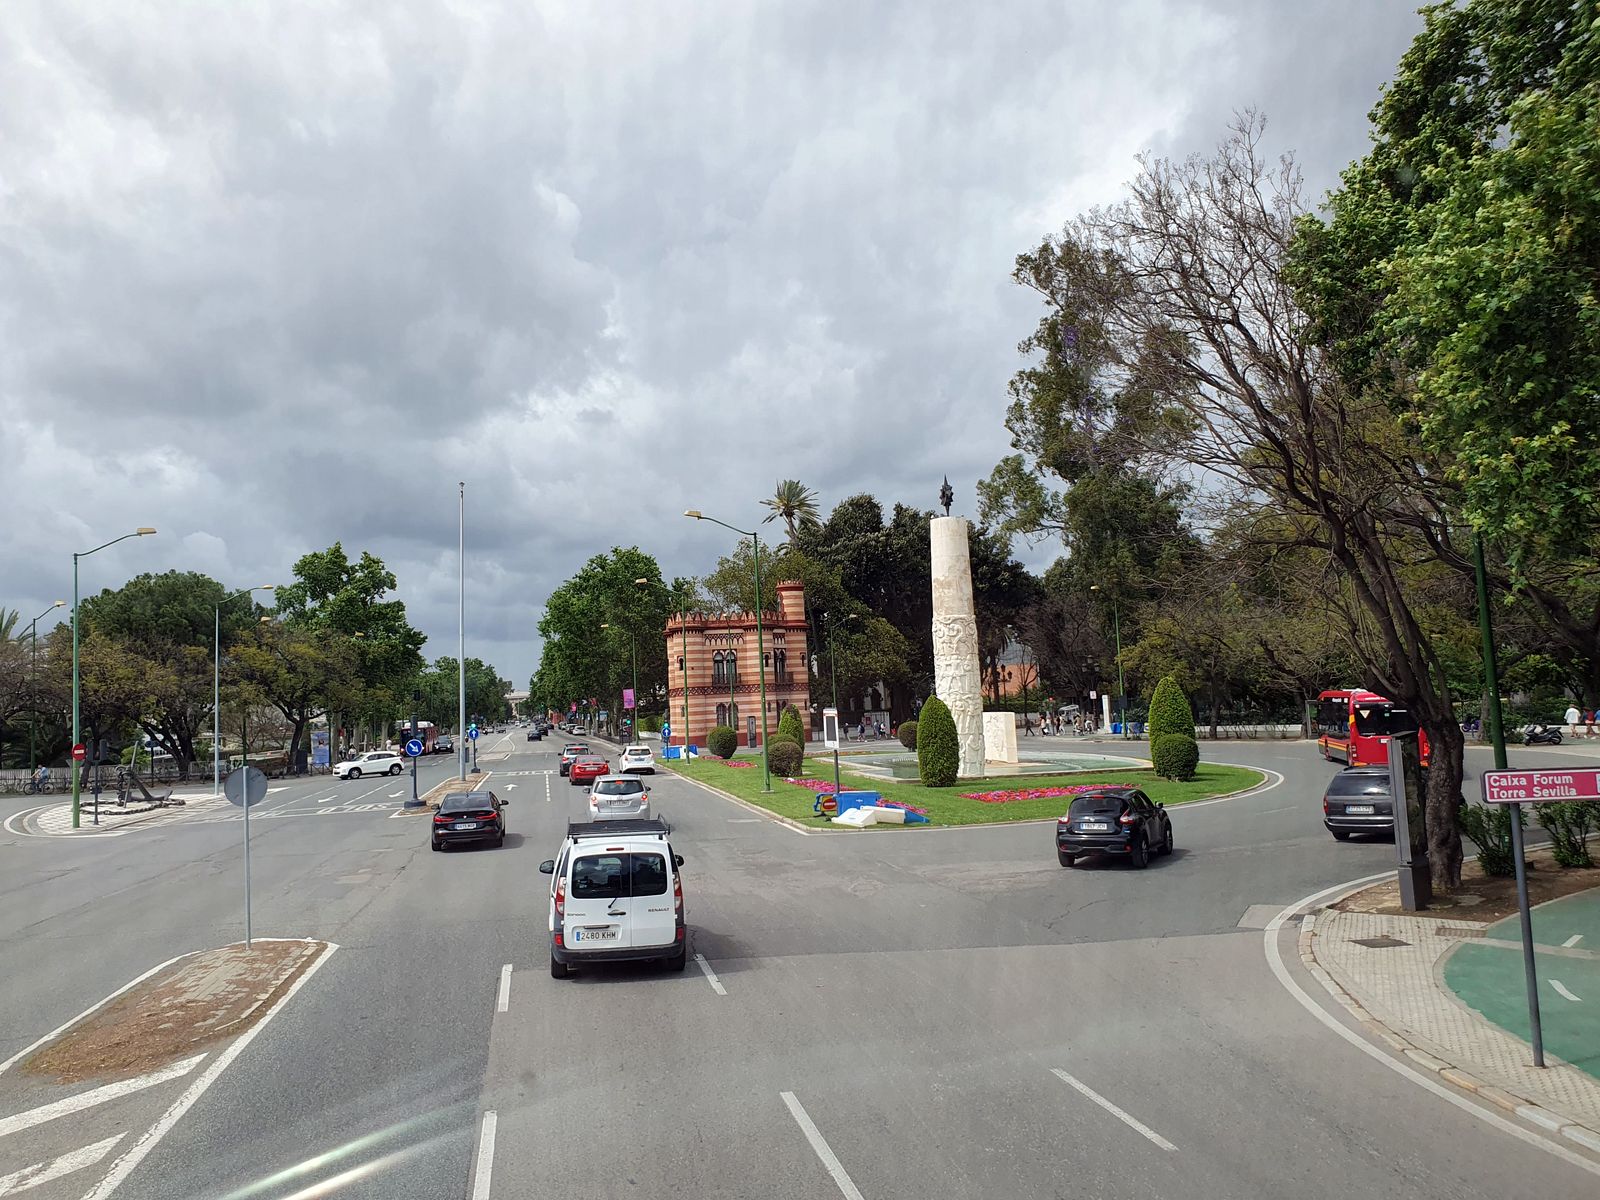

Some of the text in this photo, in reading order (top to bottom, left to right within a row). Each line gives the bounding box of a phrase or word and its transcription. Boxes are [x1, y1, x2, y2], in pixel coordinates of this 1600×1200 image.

[1490, 774, 1573, 787] Caixa Forum
[1491, 786, 1577, 799] Torre Sevilla
[581, 931, 616, 940] 2480 KHM
